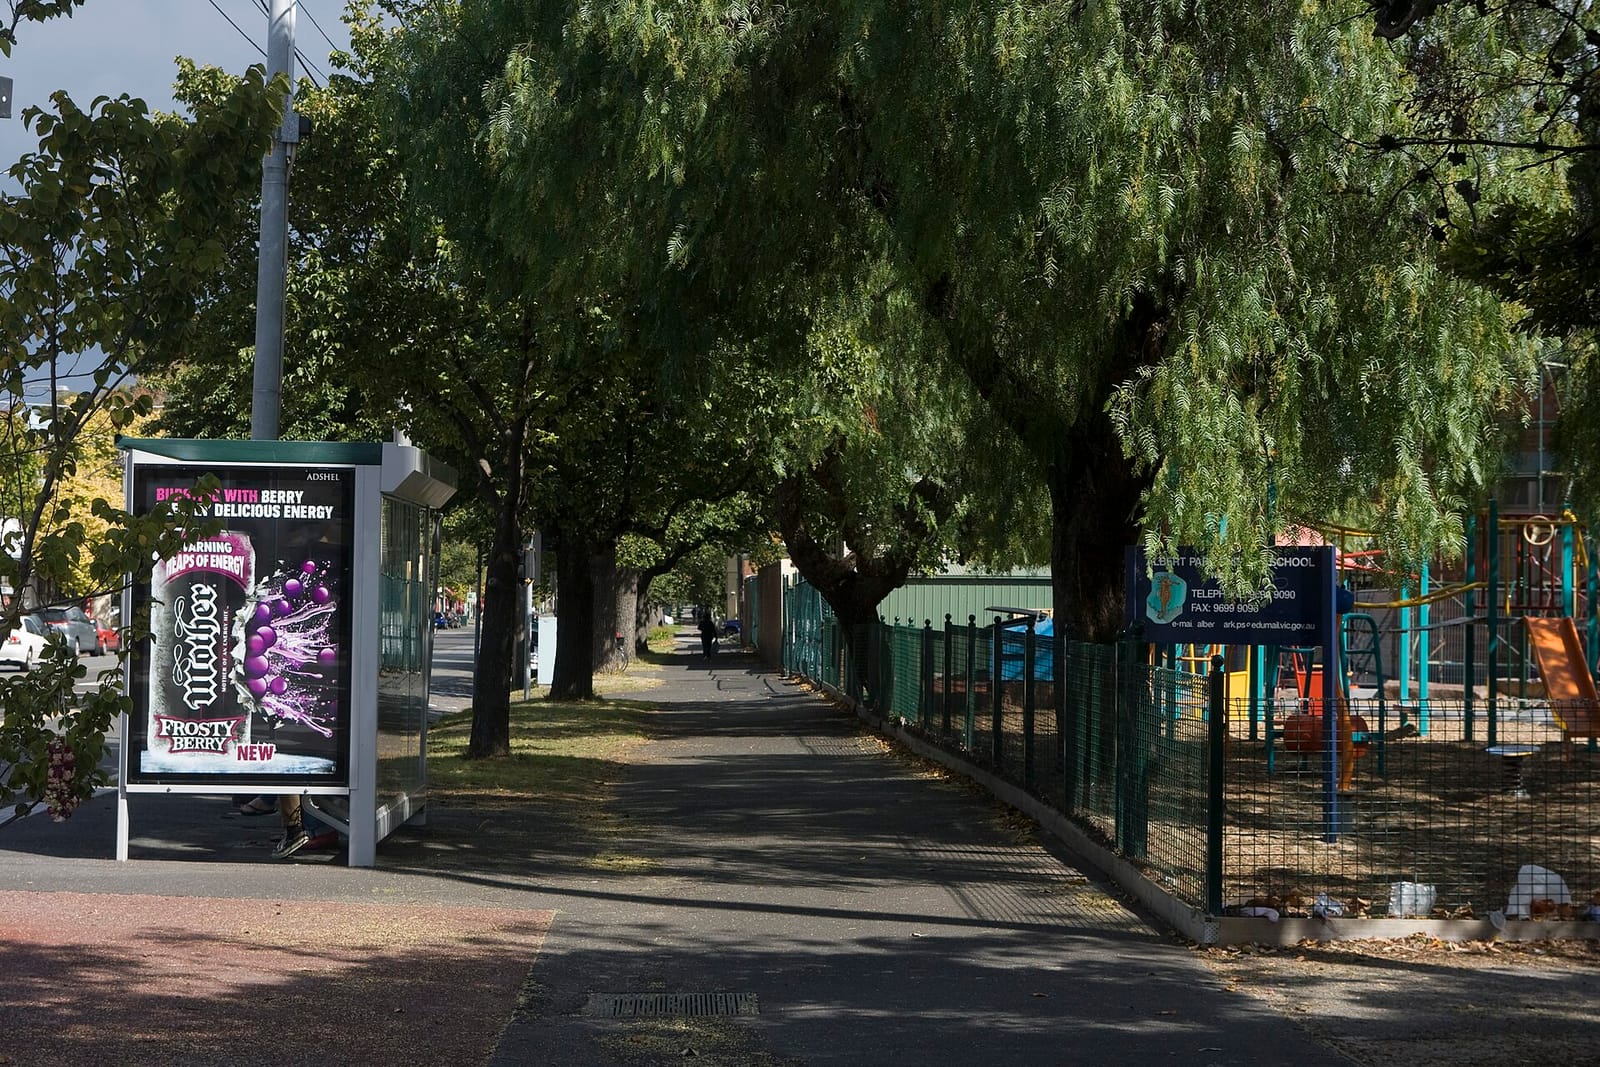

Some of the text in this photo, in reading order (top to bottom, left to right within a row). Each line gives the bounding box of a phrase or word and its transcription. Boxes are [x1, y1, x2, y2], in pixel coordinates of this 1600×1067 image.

[306, 472, 340, 481] ADSHEL
[224, 490, 258, 502] WITH
[262, 490, 304, 504] BERRY
[214, 504, 280, 518] DELICIOUS
[284, 506, 334, 520] ENERGY
[196, 554, 208, 568] OF
[210, 555, 245, 578] ENERGY
[1270, 557, 1316, 568] SCHOOL
[1274, 590, 1296, 600] 9090
[1191, 603, 1211, 612] FAX:
[1213, 604, 1234, 613] 9699
[160, 718, 236, 738] FROSTY
[172, 736, 226, 752] BERRY
[237, 744, 276, 761] NEW
